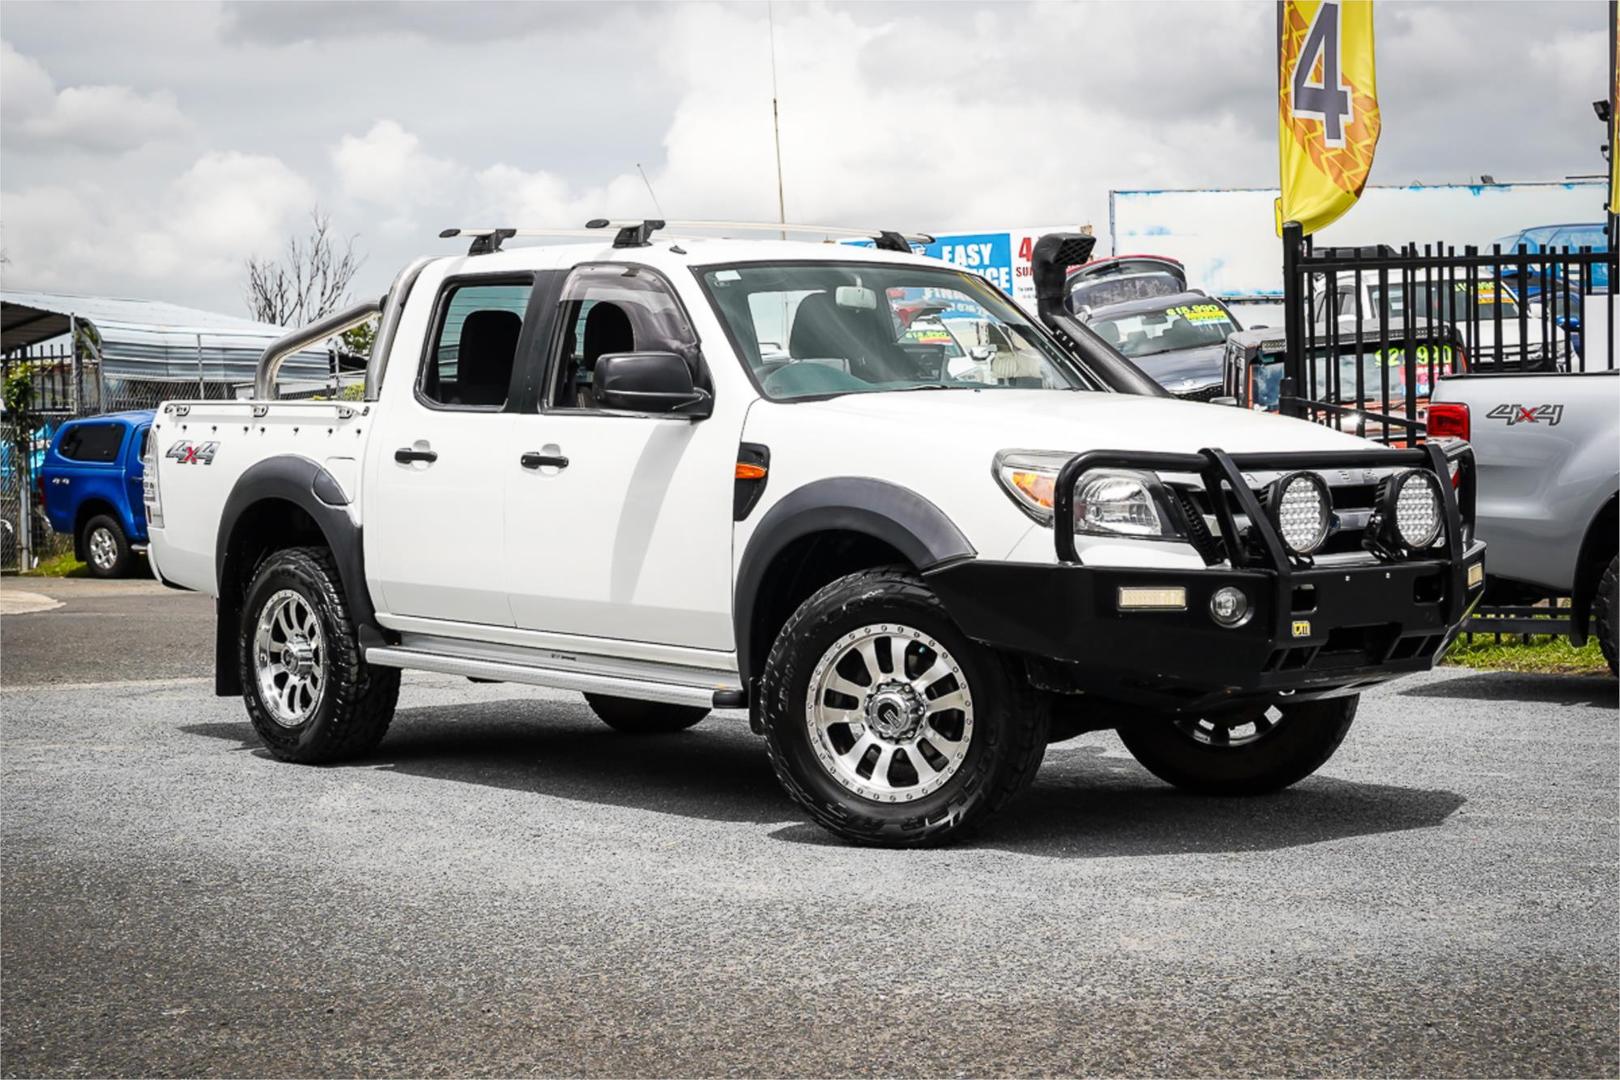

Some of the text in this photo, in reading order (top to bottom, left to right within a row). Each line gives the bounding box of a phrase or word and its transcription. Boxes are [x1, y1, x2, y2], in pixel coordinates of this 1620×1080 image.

[1292, 0, 1354, 148] 4
[941, 243, 993, 267] EASY
[1485, 403, 1564, 426] 4x4
[165, 439, 221, 465] 4x4
